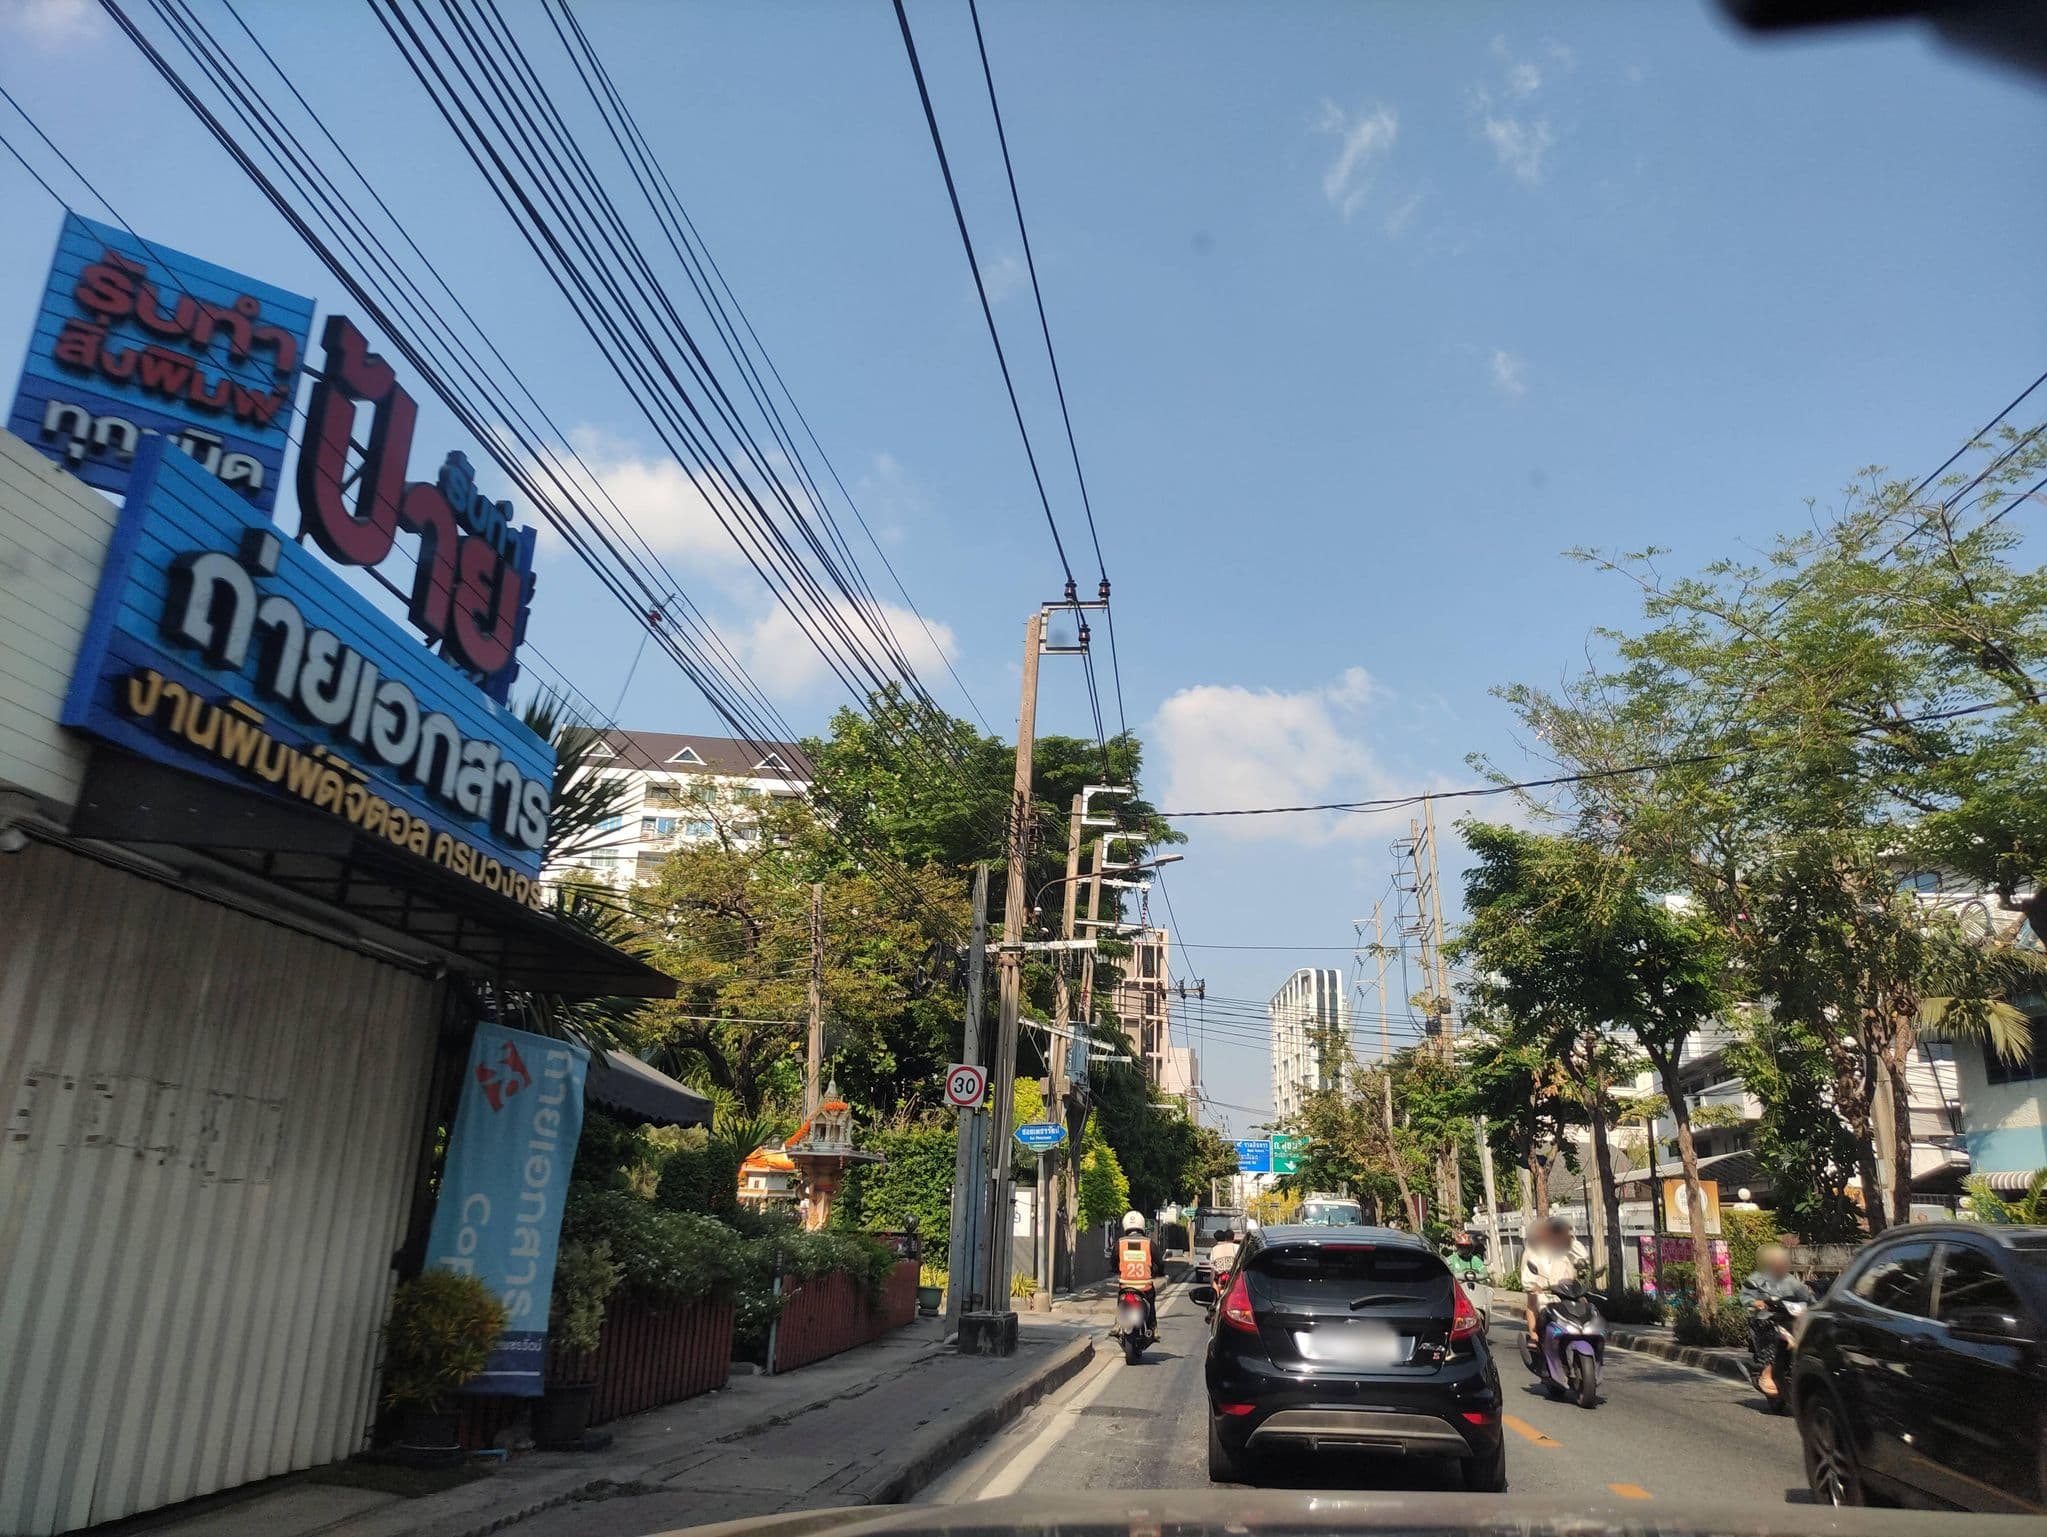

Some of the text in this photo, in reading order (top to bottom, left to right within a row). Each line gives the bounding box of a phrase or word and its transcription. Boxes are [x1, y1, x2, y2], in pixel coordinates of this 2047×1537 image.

[54, 314, 290, 425] สิ่งพิมพ์
[75, 248, 298, 374] รับทำ
[43, 399, 265, 489] ทุกนิด
[298, 315, 521, 674] ป้าย
[180, 529, 550, 851] ถ่ายเอกสาร
[128, 662, 543, 914] งานพิมพ์ดิจิตอล ครบวงจร
[953, 1076, 976, 1095] 30
[503, 1048, 581, 1320] ถ่ายเอกสาร
[1127, 1263, 1145, 1278] 23
